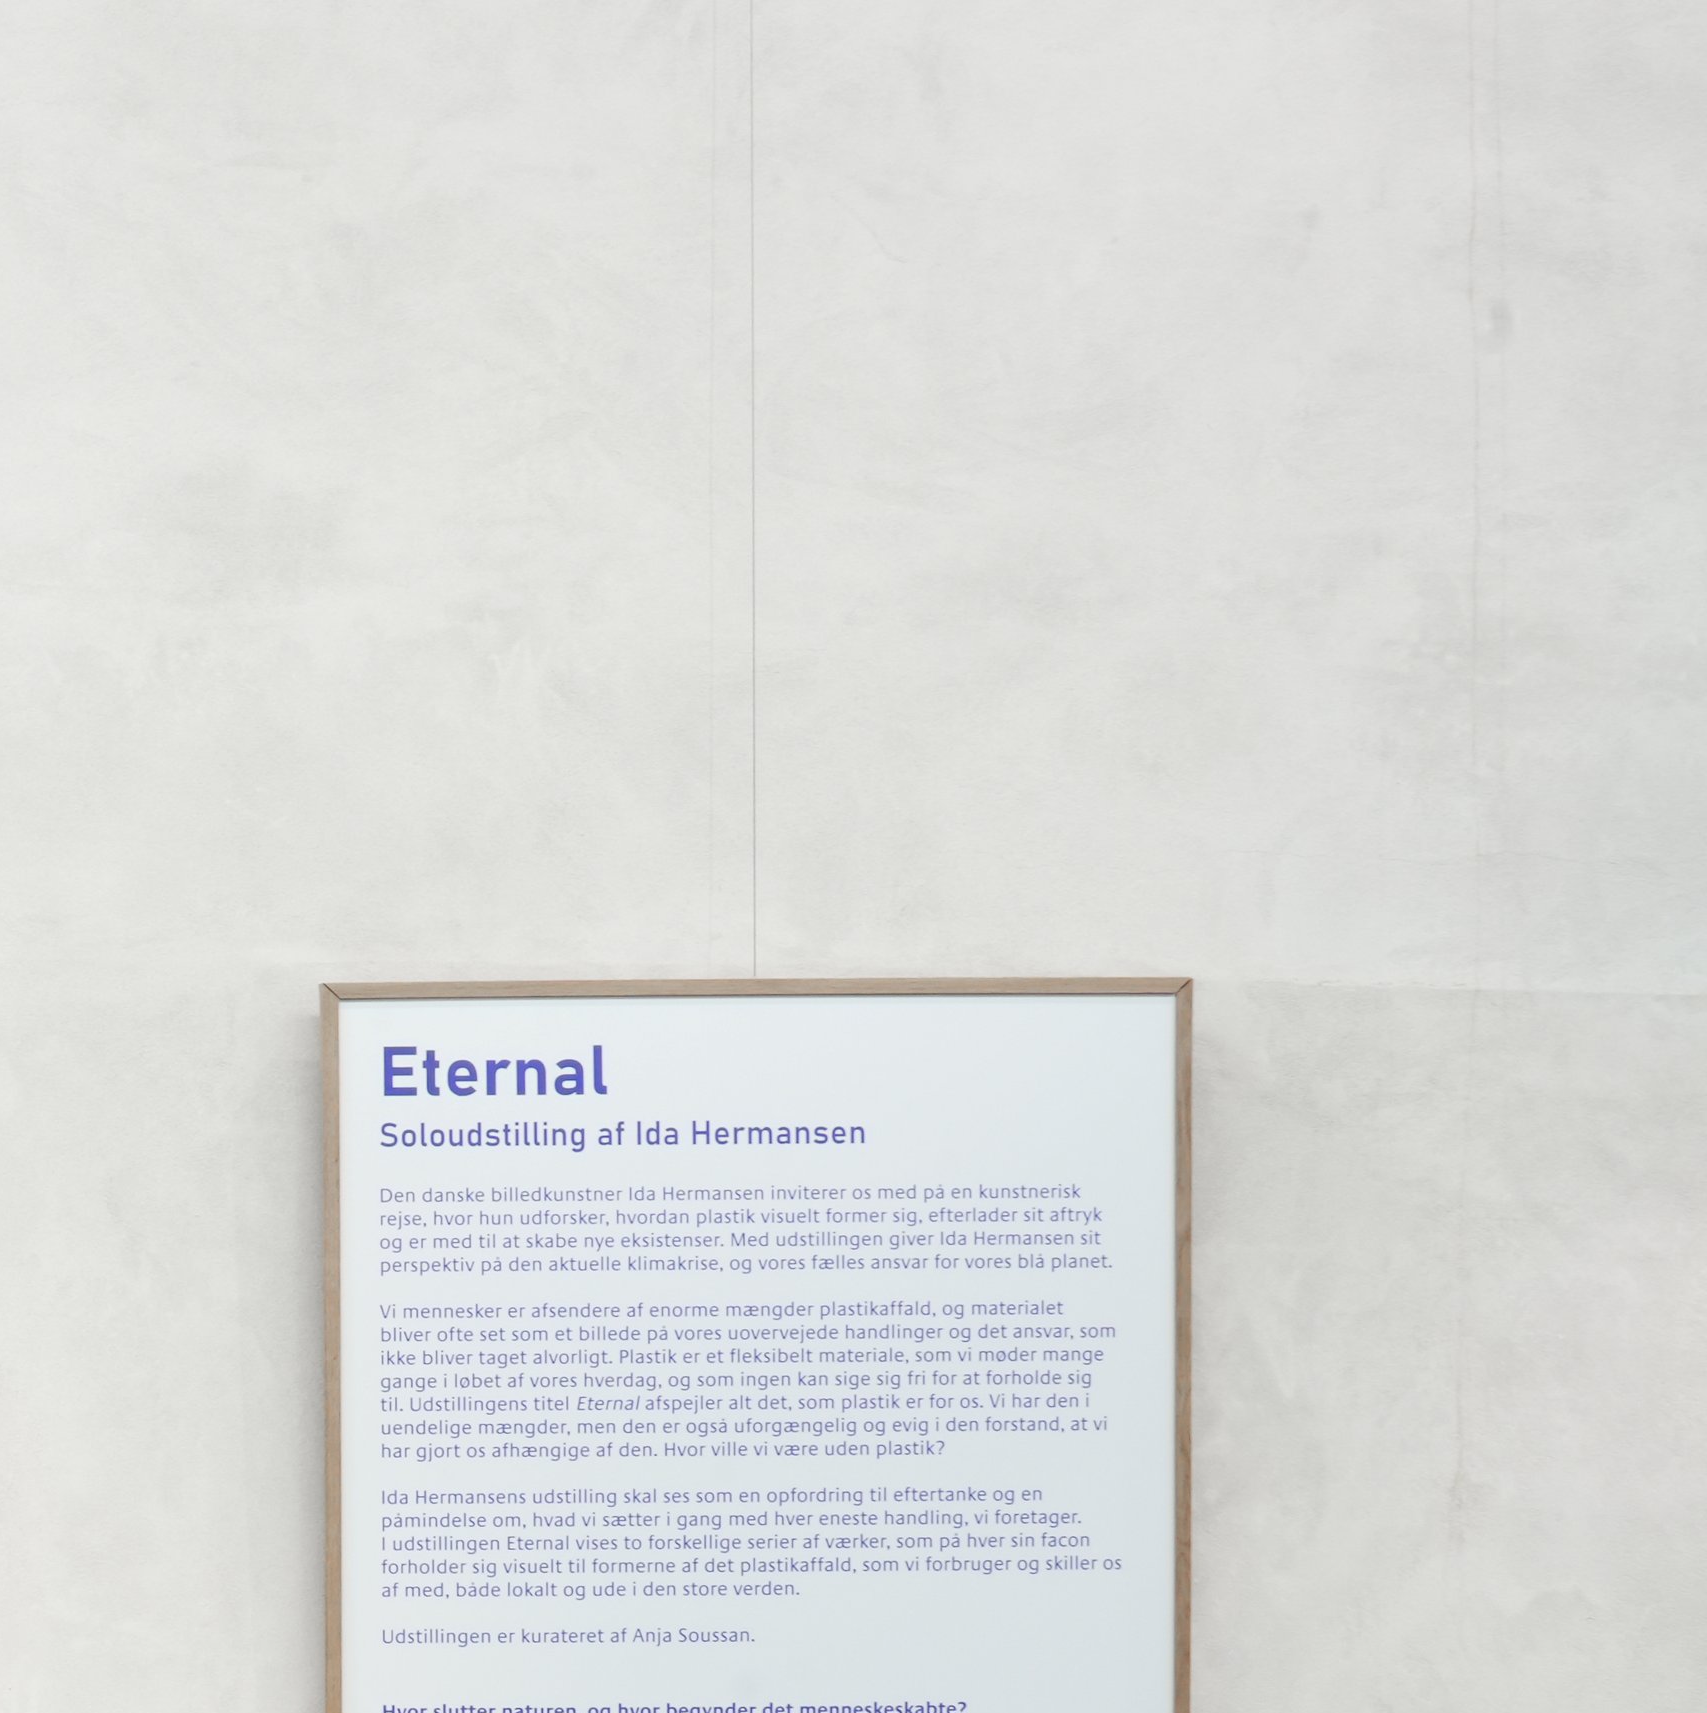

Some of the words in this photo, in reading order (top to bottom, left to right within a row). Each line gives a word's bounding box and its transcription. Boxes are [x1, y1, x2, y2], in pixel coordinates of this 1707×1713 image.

[382, 1044, 609, 1098] Eternal
[379, 1120, 586, 1154] Soloudstilling
[597, 1120, 626, 1147] af
[636, 1120, 680, 1147] Ida
[691, 1119, 866, 1146] Hermansen
[379, 1187, 416, 1204] Den
[421, 1186, 486, 1203] danske
[491, 1186, 624, 1203] billedkunstner
[628, 1185, 656, 1202] Ida
[662, 1185, 765, 1202] Hermansen
[770, 1184, 848, 1201] inviterer
[851, 1187, 872, 1201] os
[877, 1183, 917, 1200] med
[923, 1183, 945, 1204] på
[950, 1187, 973, 1200] en
[978, 1183, 1082, 1200] kunstnerisk
[379, 1303, 396, 1320] Vi
[402, 1303, 504, 1320] mennesker
[507, 1306, 527, 1319] er
[530, 1301, 622, 1319] afsendere
[626, 1301, 644, 1318] af
[648, 1305, 720, 1318] enorme
[725, 1300, 816, 1321] mængder
[819, 1299, 937, 1321] plastikaffald,
[941, 1303, 965, 1320] og
[970, 1299, 1064, 1316] materialet
[380, 1349, 417, 1366] ikke
[422, 1349, 474, 1366] bliver
[477, 1350, 528, 1370] taget
[532, 1348, 614, 1369] alvorligt.
[618, 1348, 678, 1365] Plastik
[682, 1351, 702, 1365] er
[705, 1349, 725, 1365] et
[728, 1347, 814, 1364] fleksibelt
[818, 1346, 910, 1365] materiale,
[914, 1350, 953, 1363] som
[956, 1346, 972, 1363] vi
[978, 1346, 1038, 1363] møder
[1042, 1349, 1105, 1366] mange
[381, 1442, 412, 1459] har
[415, 1442, 462, 1463] gjort
[465, 1445, 487, 1459] os
[491, 1441, 591, 1462] afhængige
[595, 1440, 614, 1458] af
[618, 1441, 658, 1458] den.
[663, 1441, 707, 1458] Hvor
[710, 1440, 749, 1457] ville
[752, 1440, 769, 1457] vi
[773, 1443, 819, 1457] være
[824, 1439, 870, 1457] uden
[876, 1439, 946, 1460] plastik?
[381, 1489, 409, 1506] Ida
[415, 1489, 527, 1505] Hermansens
[532, 1487, 618, 1509] udstilling
[622, 1487, 657, 1505] skal
[662, 1491, 691, 1504] ses
[695, 1491, 733, 1504] som
[738, 1490, 761, 1504] en
[766, 1486, 864, 1508] opfordring
[868, 1486, 888, 1503] til
[892, 1485, 988, 1503] eftertanke
[991, 1489, 1016, 1506] og
[1020, 1489, 1043, 1502] en
[381, 1581, 400, 1598] af
[404, 1581, 450, 1600] med,
[455, 1581, 502, 1598] både
[506, 1580, 559, 1598] lokalt
[562, 1584, 587, 1602] og
[592, 1580, 627, 1597] ude
[631, 1580, 637, 1597] i
[642, 1580, 677, 1597] den
[682, 1581, 729, 1597] store
[732, 1580, 801, 1597] verden.
[381, 1628, 492, 1648] Udstillingen
[497, 1631, 516, 1644] er
[520, 1627, 606, 1644] kurateret
[609, 1626, 628, 1644] af
[631, 1627, 673, 1648] Anja
[677, 1627, 756, 1644] Soussan.
